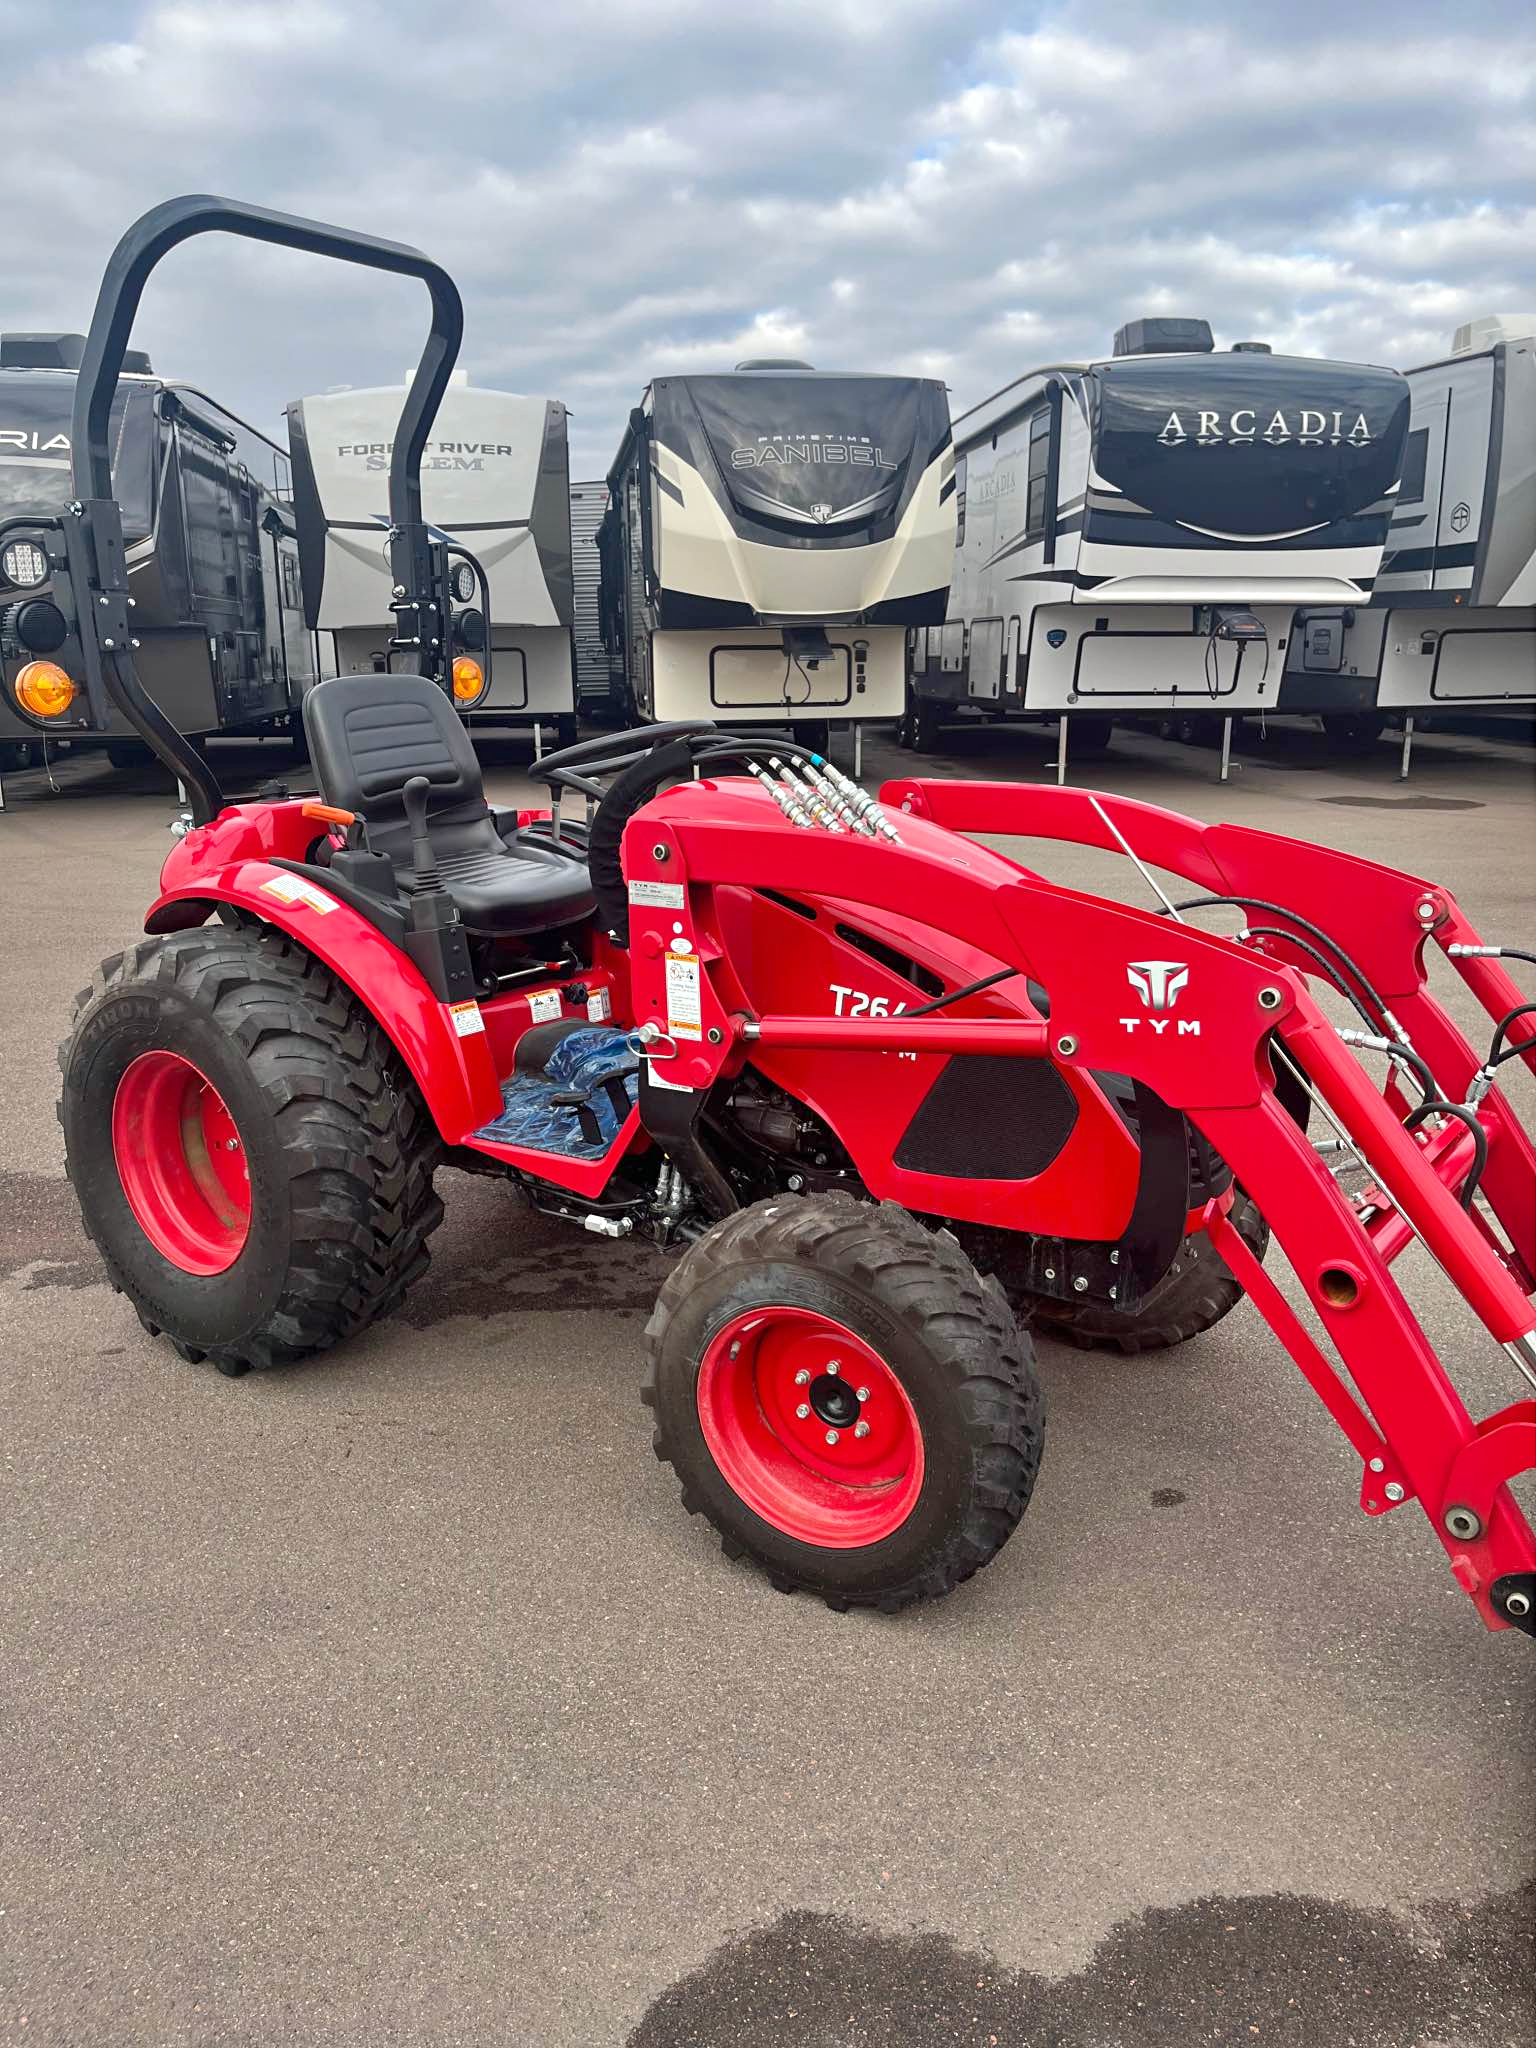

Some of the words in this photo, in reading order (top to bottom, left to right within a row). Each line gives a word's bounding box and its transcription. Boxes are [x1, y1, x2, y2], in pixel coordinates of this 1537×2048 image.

[1157, 409, 1372, 438] ARCADIA
[338, 443, 433, 457] FORT
[439, 442, 512, 456] RIVER
[731, 444, 898, 471] SANIBEL
[366, 455, 485, 471] SEM
[1119, 1018, 1200, 1036] TYM
